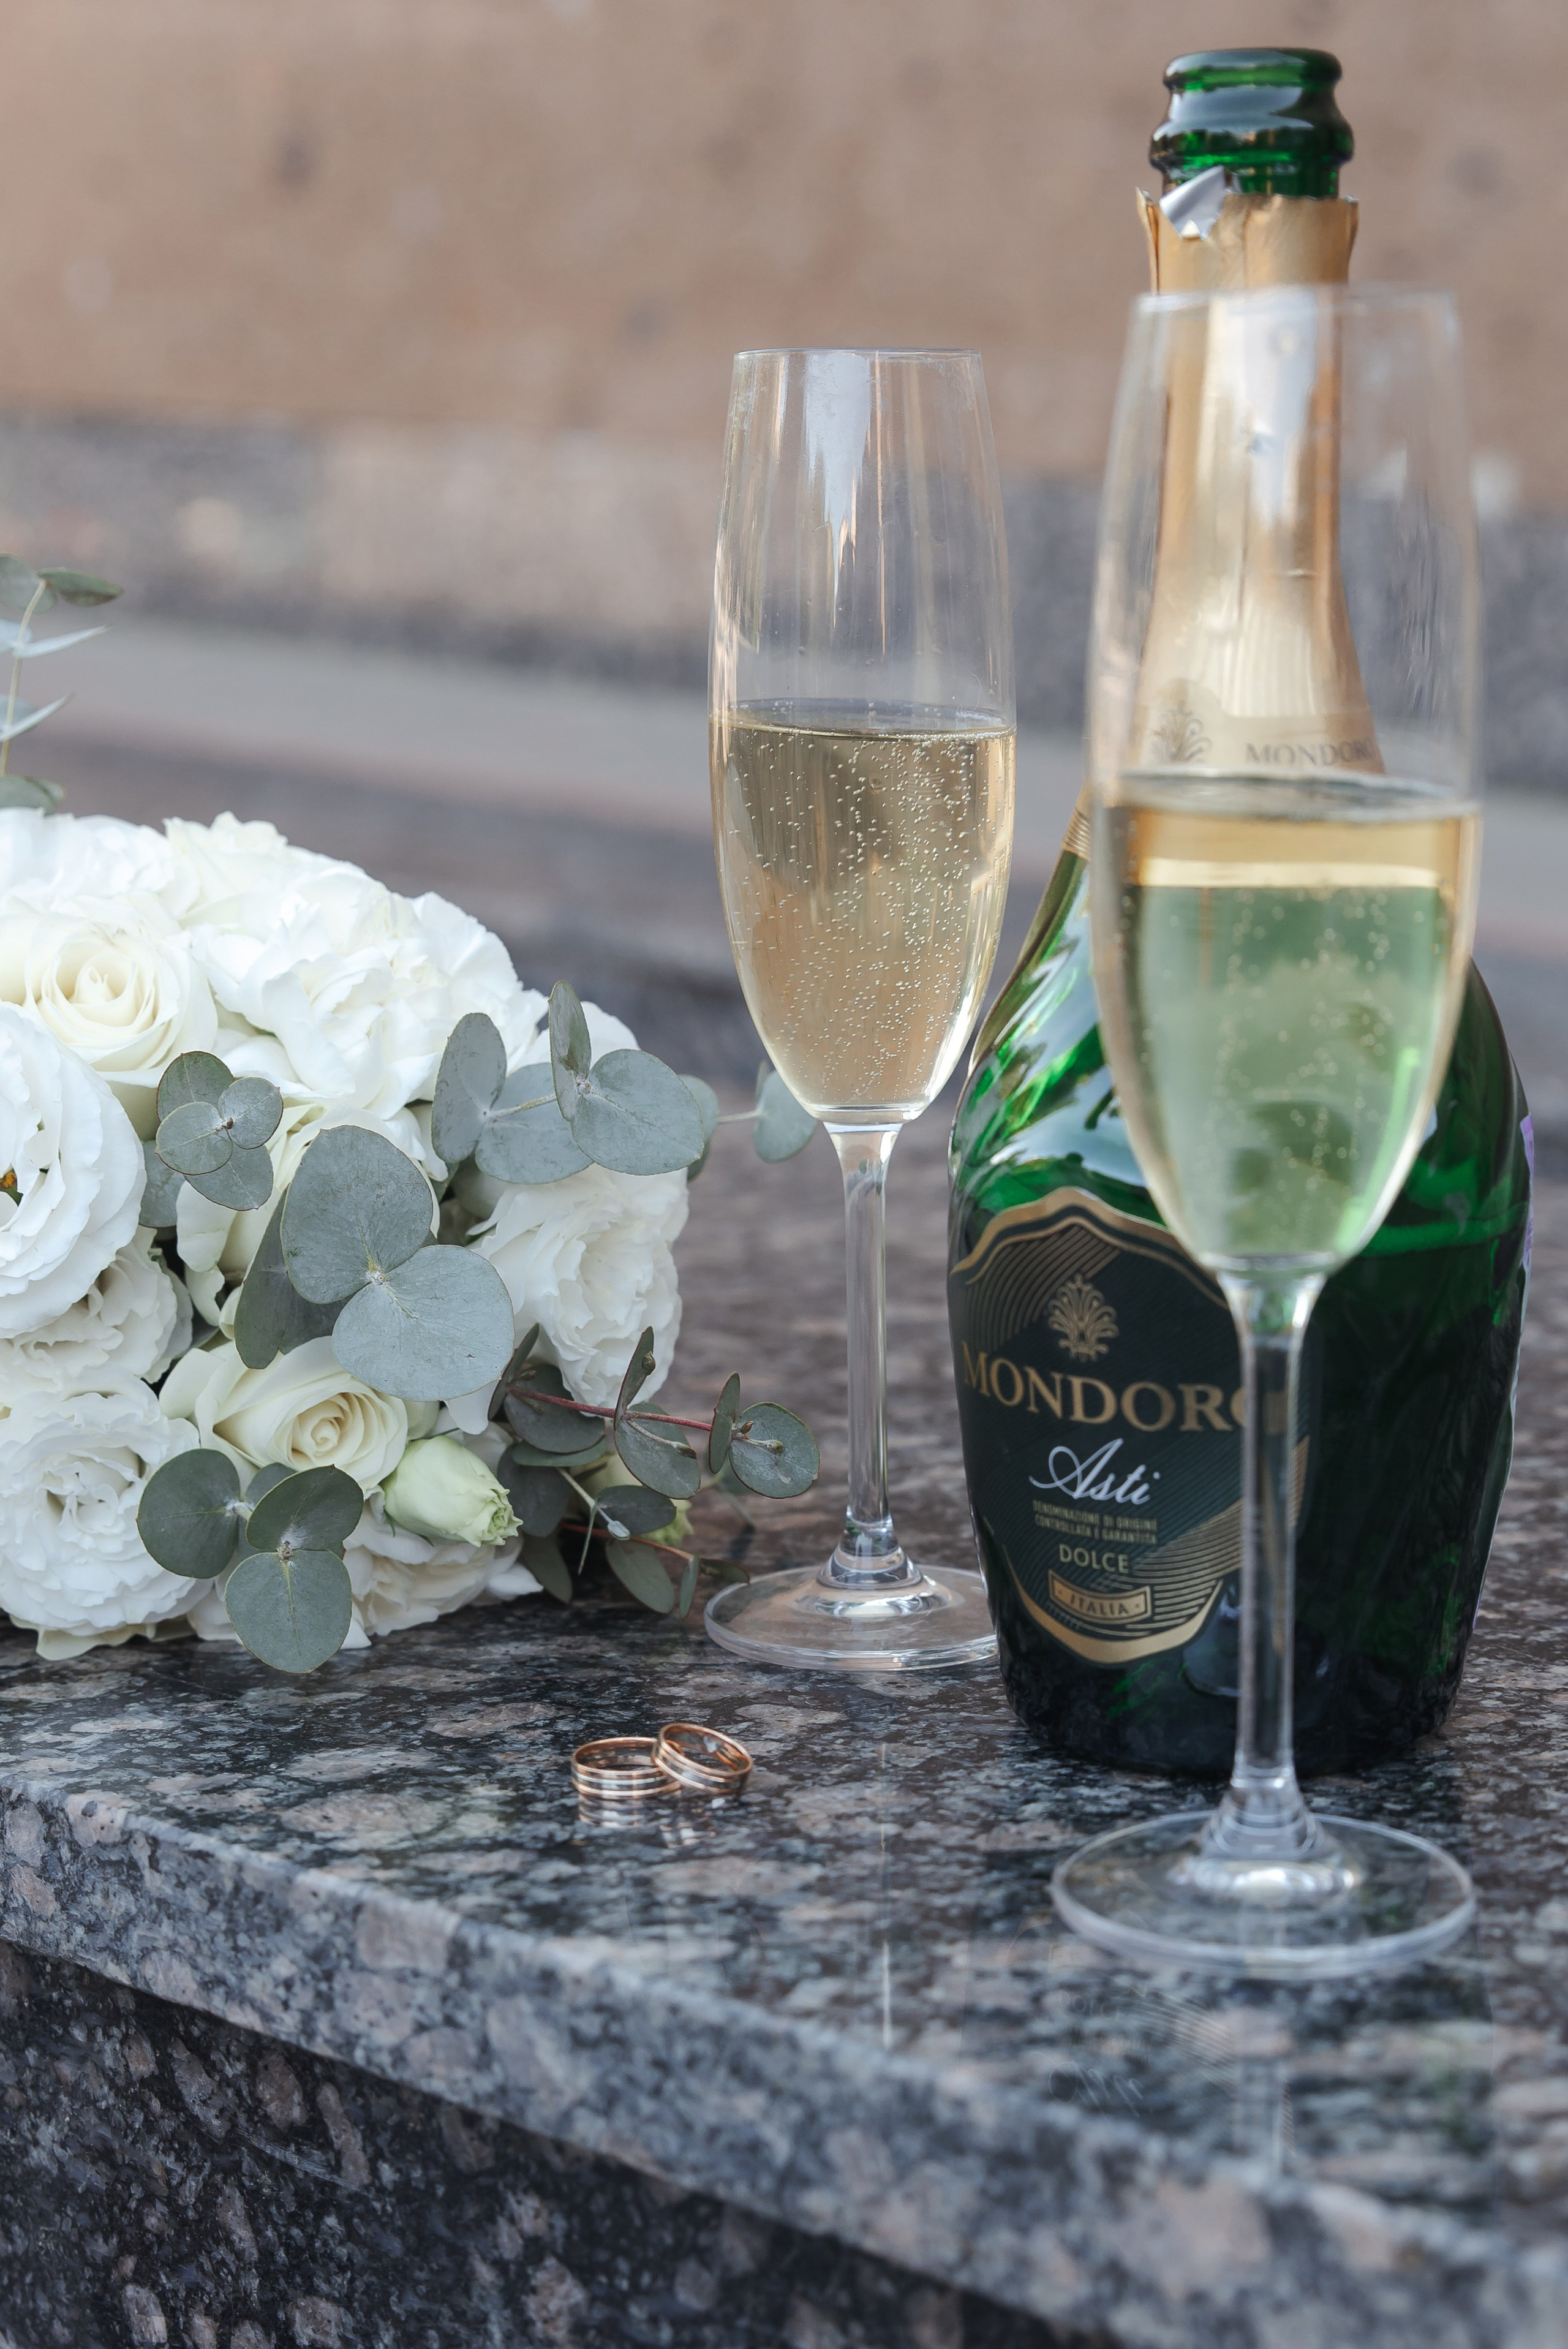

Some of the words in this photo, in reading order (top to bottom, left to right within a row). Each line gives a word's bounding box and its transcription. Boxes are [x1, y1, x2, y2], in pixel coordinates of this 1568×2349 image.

[1029, 1437, 1161, 1505] Asti
[1059, 1544, 1129, 1573] DOLCE
[1071, 1594, 1128, 1616] ITALIA
